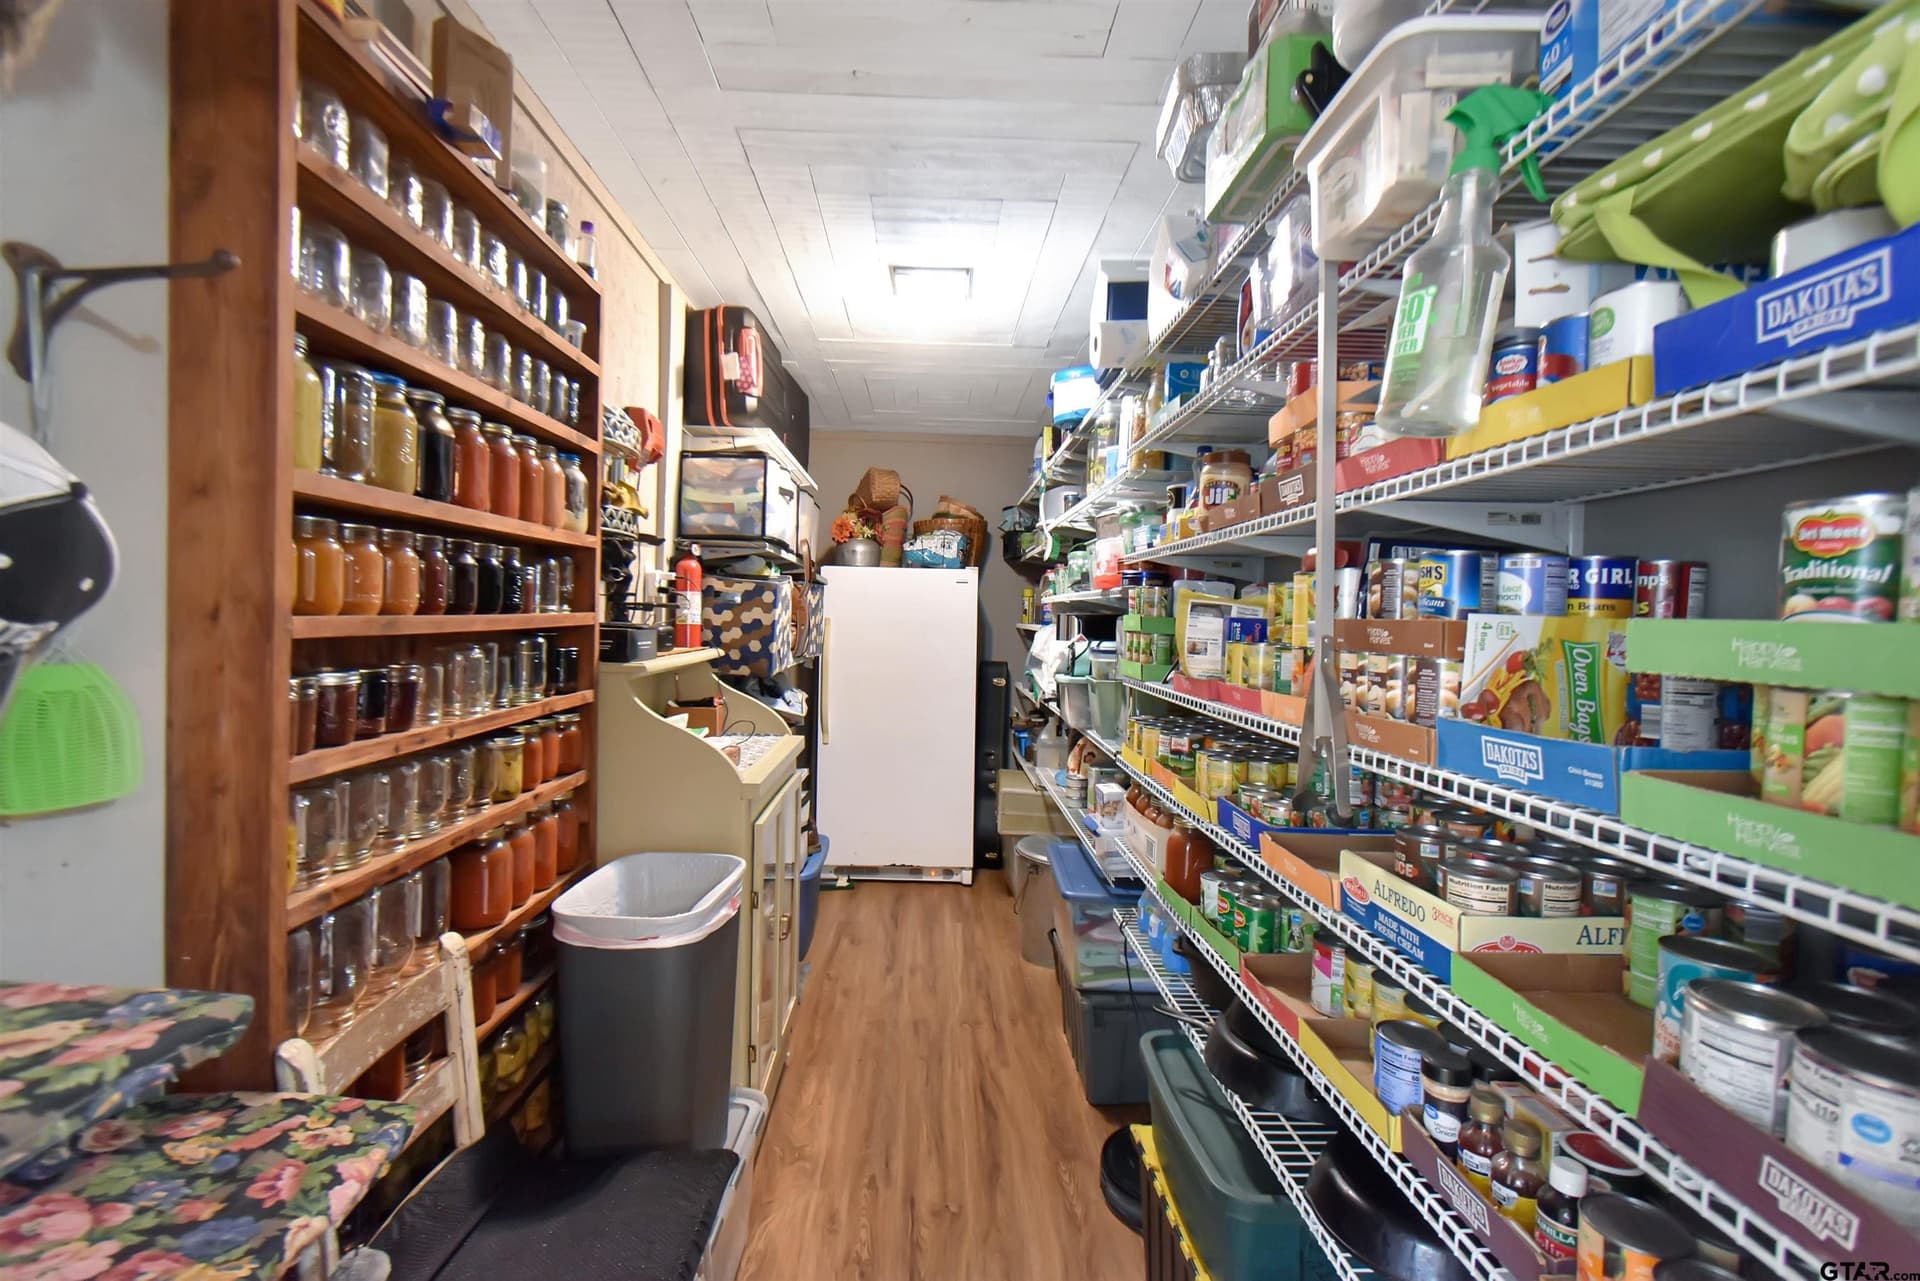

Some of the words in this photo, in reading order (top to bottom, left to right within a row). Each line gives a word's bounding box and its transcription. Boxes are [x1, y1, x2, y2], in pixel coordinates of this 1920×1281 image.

[1491, 379, 1530, 393] vegetable
[1421, 565, 1443, 580] SH'S
[1584, 567, 1633, 585] GIRL
[1783, 560, 1894, 584] Traditional
[1497, 591, 1521, 601] nach
[1578, 602, 1616, 611] Beans
[1572, 648, 1593, 694] Oven
[1568, 699, 1596, 743] Bags
[1449, 878, 1484, 890] Nutrition
[1485, 885, 1508, 893] Facts
[1545, 884, 1576, 892] Nutrition
[1373, 880, 1426, 922] ALFREDO
[1378, 911, 1399, 932] MADE
[1400, 924, 1420, 946] WITH
[1374, 919, 1397, 943] FRESH
[1397, 936, 1424, 960] CREAM
